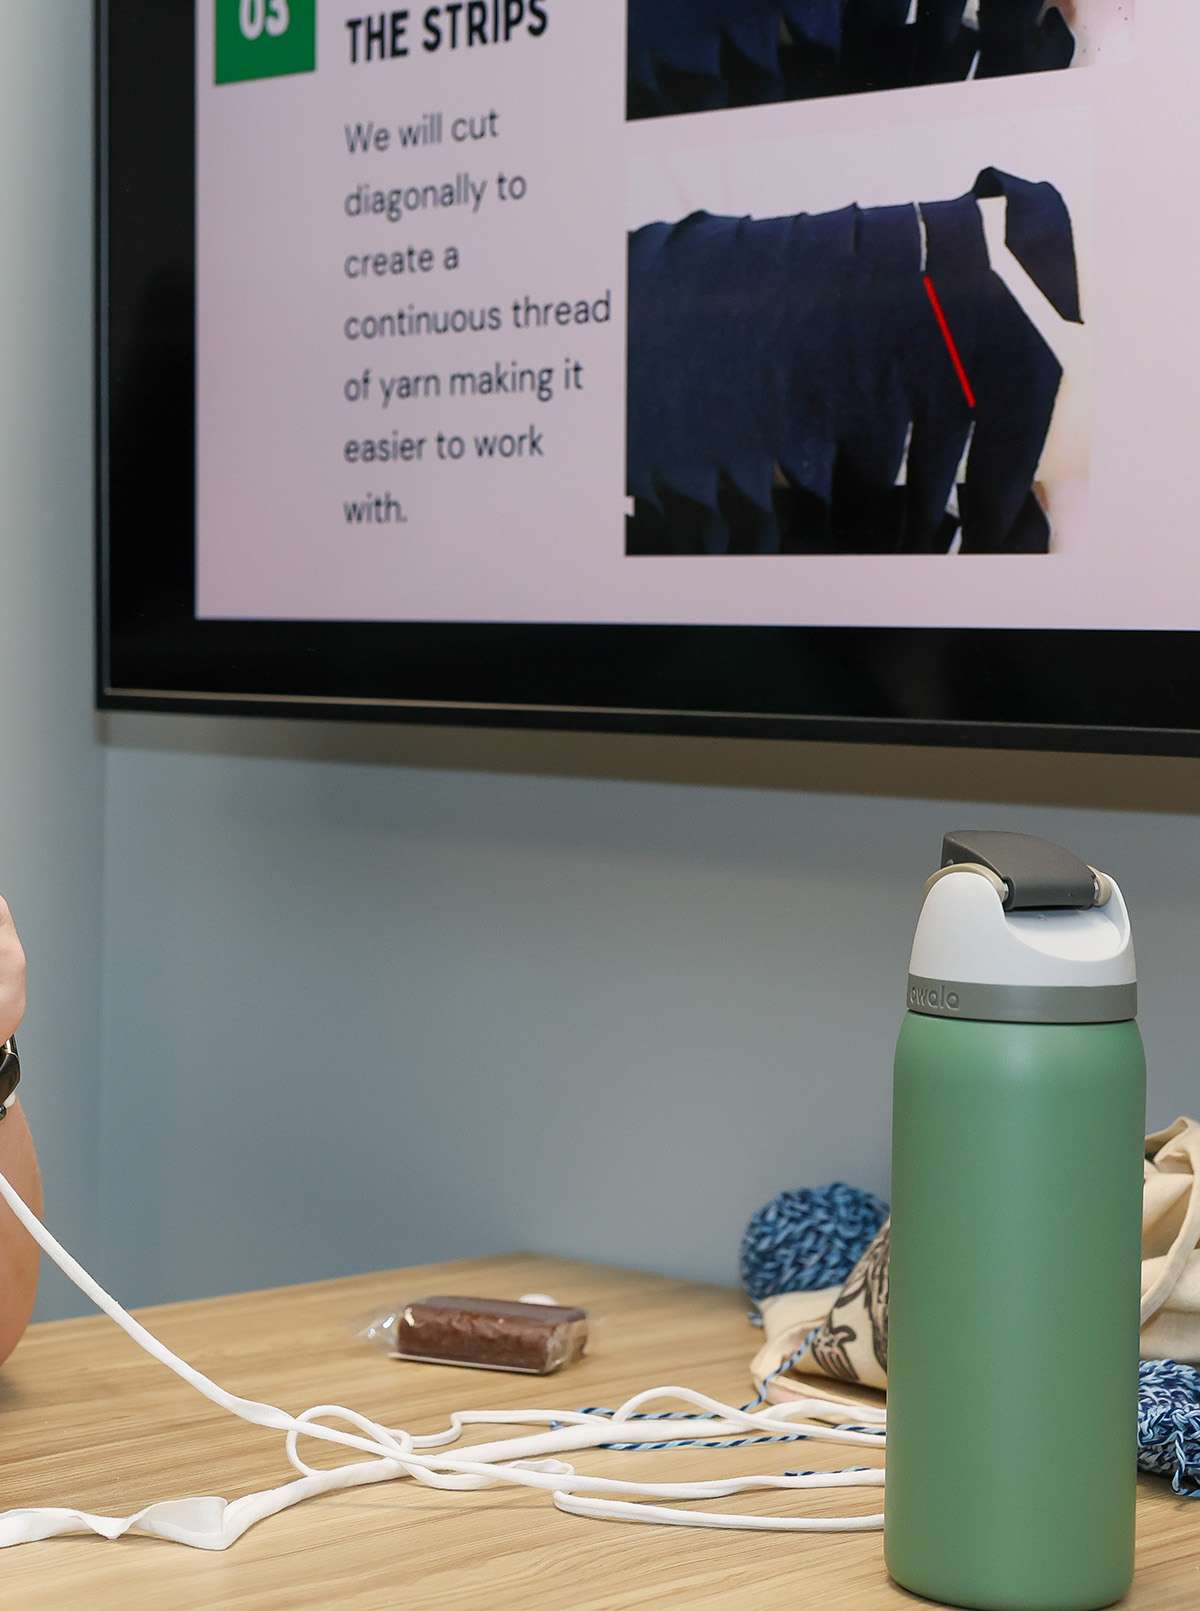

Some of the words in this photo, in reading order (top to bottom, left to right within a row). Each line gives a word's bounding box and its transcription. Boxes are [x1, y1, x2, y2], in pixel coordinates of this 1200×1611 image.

[345, 10, 409, 64] THE
[422, 0, 548, 52] STRIPS
[344, 122, 391, 154] We
[399, 113, 442, 148] will
[451, 110, 499, 142] cut
[344, 173, 487, 223] diagonally
[496, 173, 527, 201] to
[344, 246, 434, 279] create
[443, 246, 459, 271] a
[344, 304, 502, 341] continuous
[511, 289, 611, 329] thread
[344, 369, 370, 402] of
[379, 374, 441, 409] yarn
[449, 361, 554, 402] making
[564, 358, 583, 390] it
[344, 430, 427, 464] easier
[435, 432, 465, 460] to
[474, 425, 544, 458] work
[343, 492, 407, 524] with.
